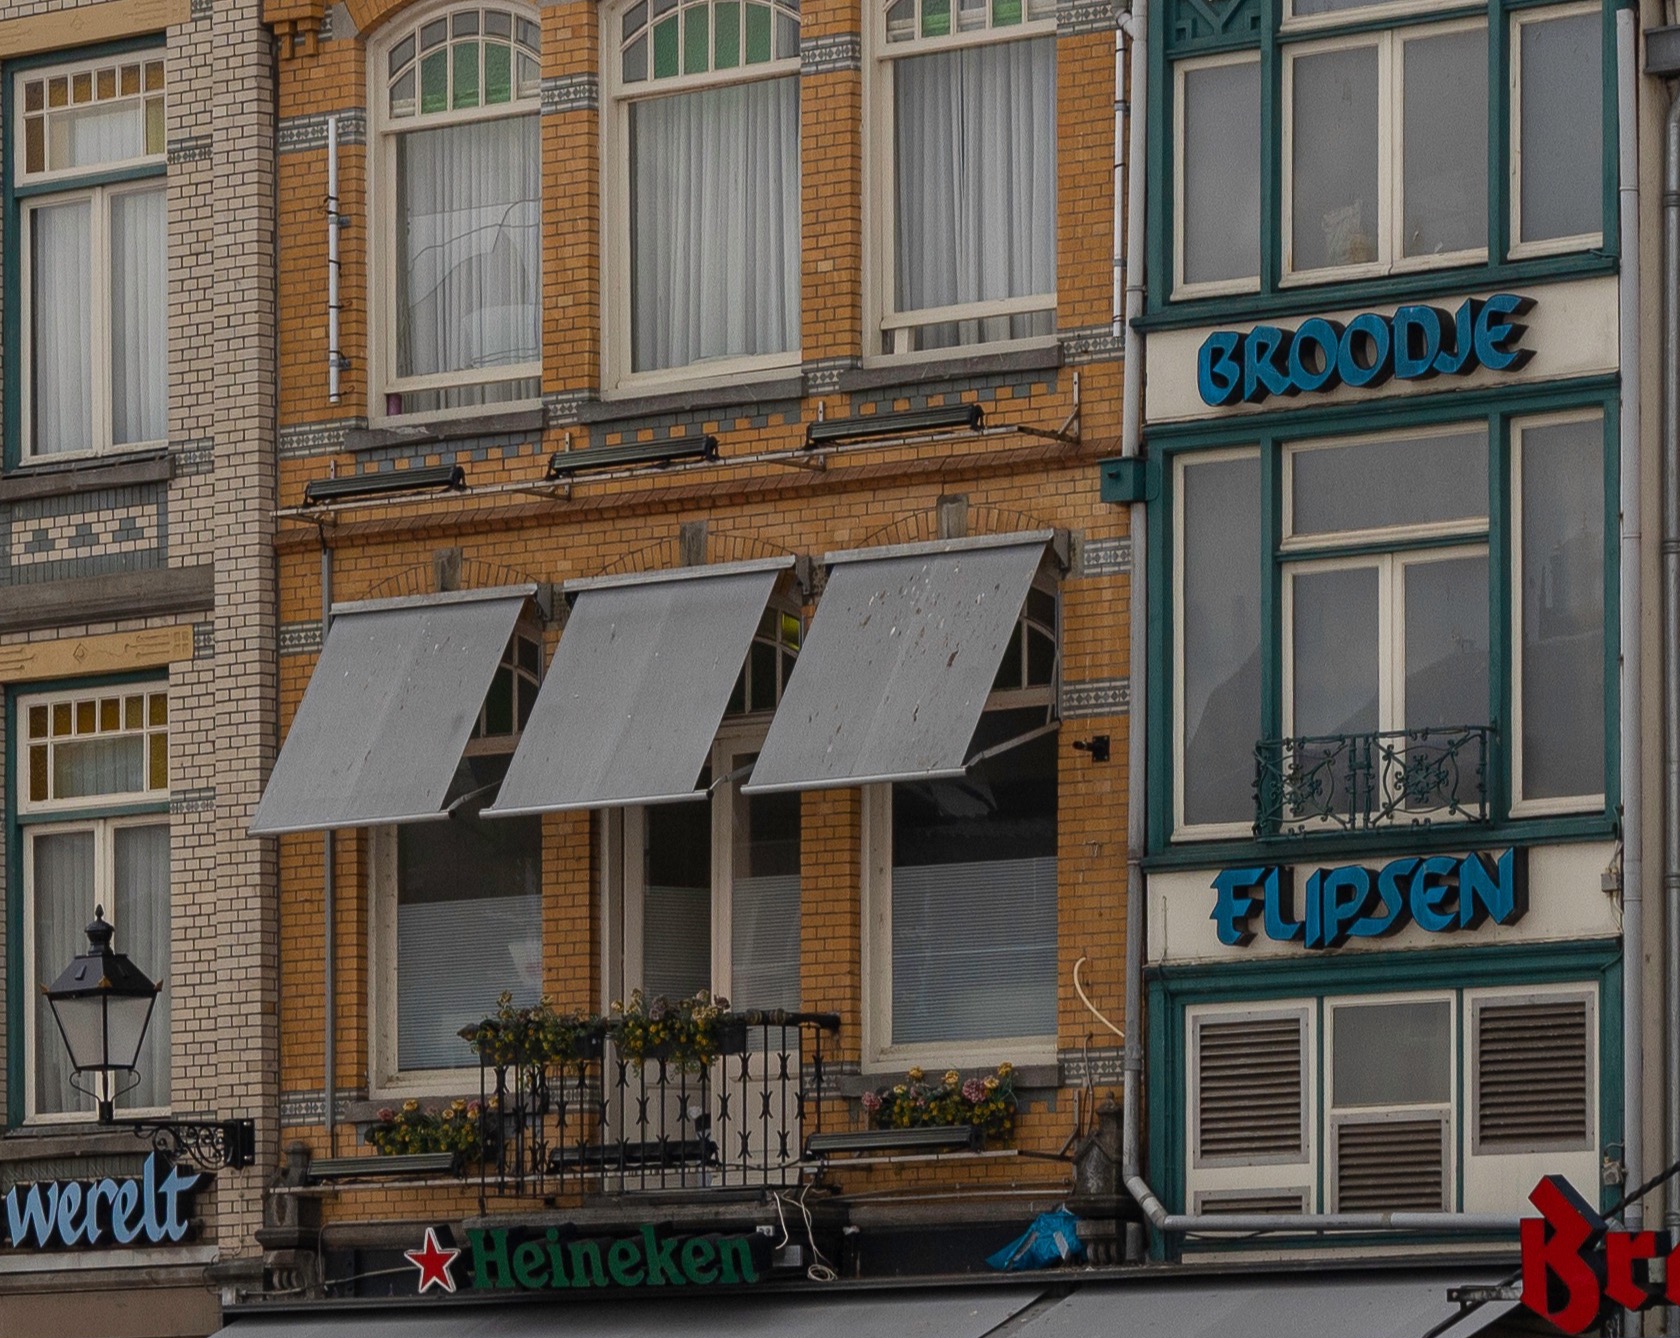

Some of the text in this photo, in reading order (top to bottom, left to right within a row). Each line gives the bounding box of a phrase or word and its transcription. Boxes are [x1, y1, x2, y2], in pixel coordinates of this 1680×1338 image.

[1197, 294, 1533, 407] BROODJE
[1211, 847, 1520, 950] FLIPSEN
[6, 1151, 203, 1248] werelt
[466, 1223, 761, 1288] Heineken
